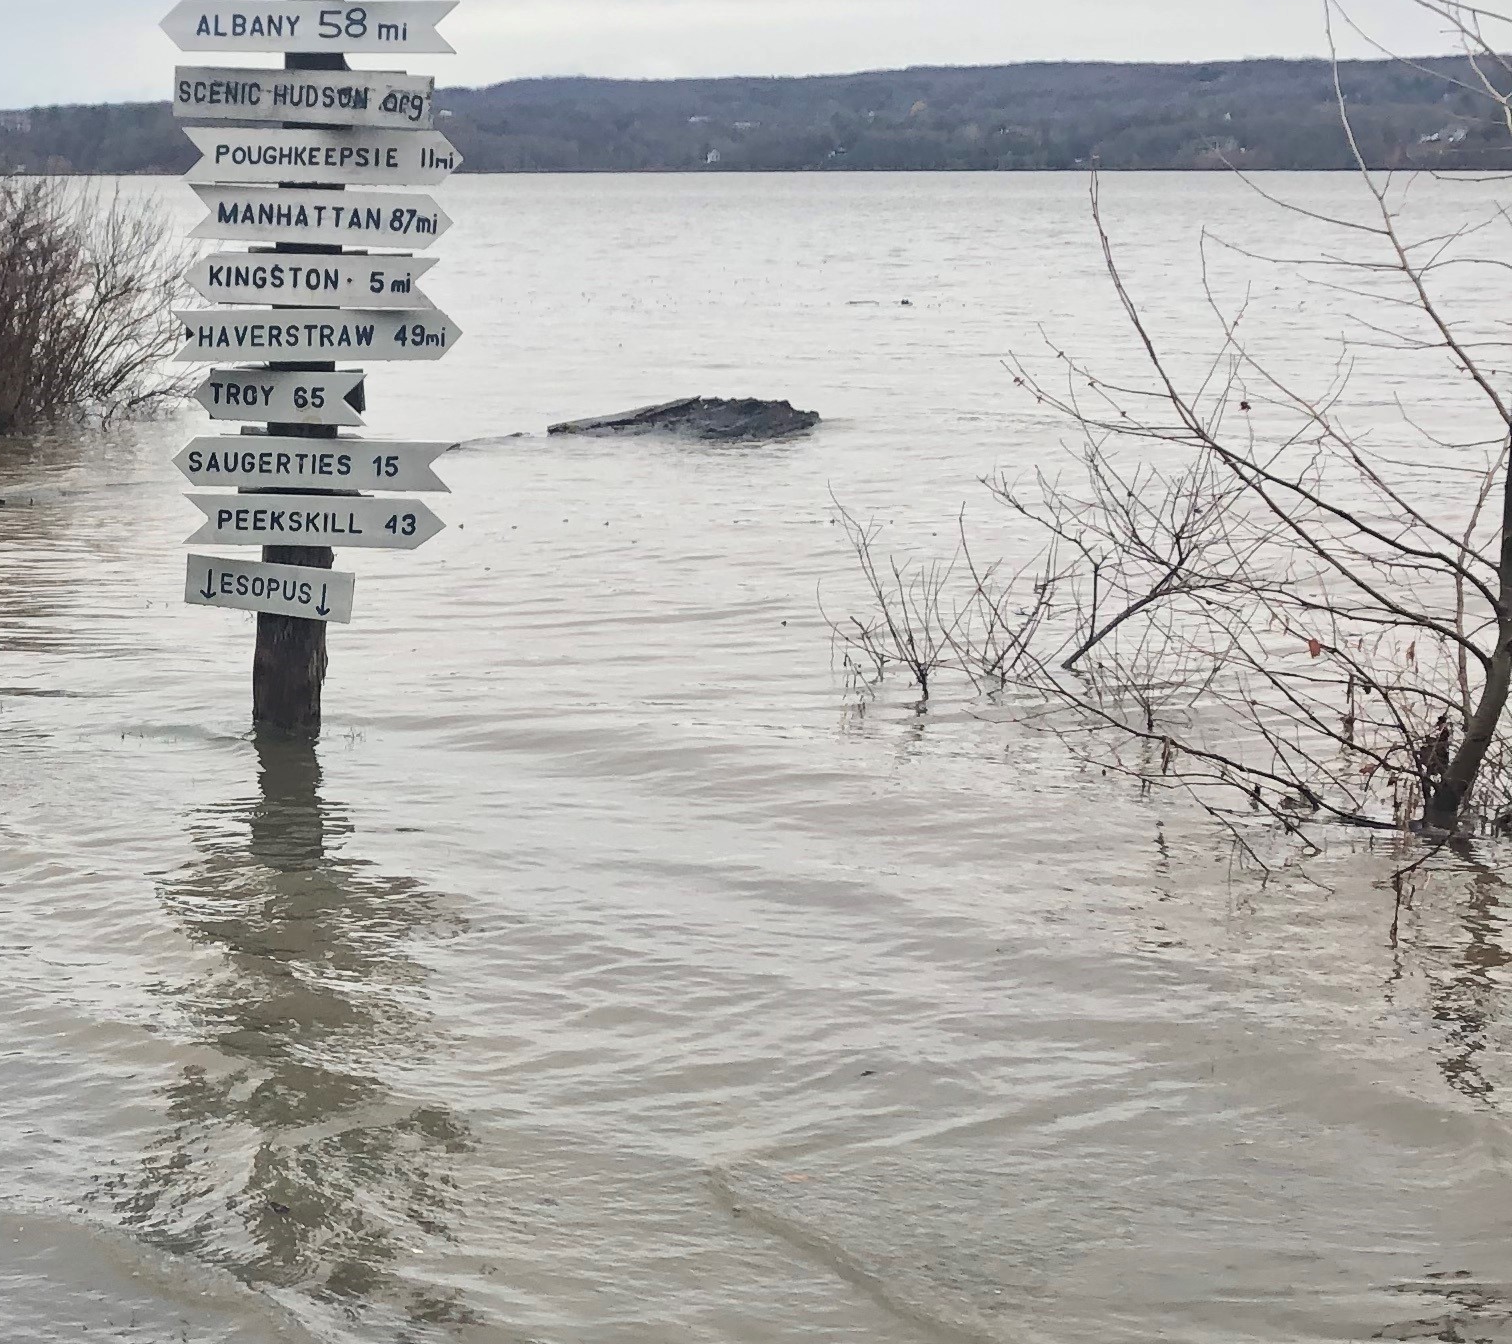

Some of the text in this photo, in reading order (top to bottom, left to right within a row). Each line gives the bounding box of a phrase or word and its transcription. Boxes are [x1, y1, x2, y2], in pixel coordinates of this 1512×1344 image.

[196, 8, 407, 41] ALBANY 58 mi
[179, 81, 261, 104] SCENIC
[273, 84, 368, 109] HUDSON
[215, 144, 398, 168] POUGHKEEPSIE
[218, 203, 381, 230] MANHATTAN
[209, 264, 339, 290] KINGSTON
[198, 324, 375, 348] HAVERSTRAW
[210, 382, 325, 409] TROY 65
[188, 452, 399, 477] SAUGERTIES 15
[217, 510, 417, 536] PEEKSKILL 43
[221, 572, 312, 604] ESOPUS
